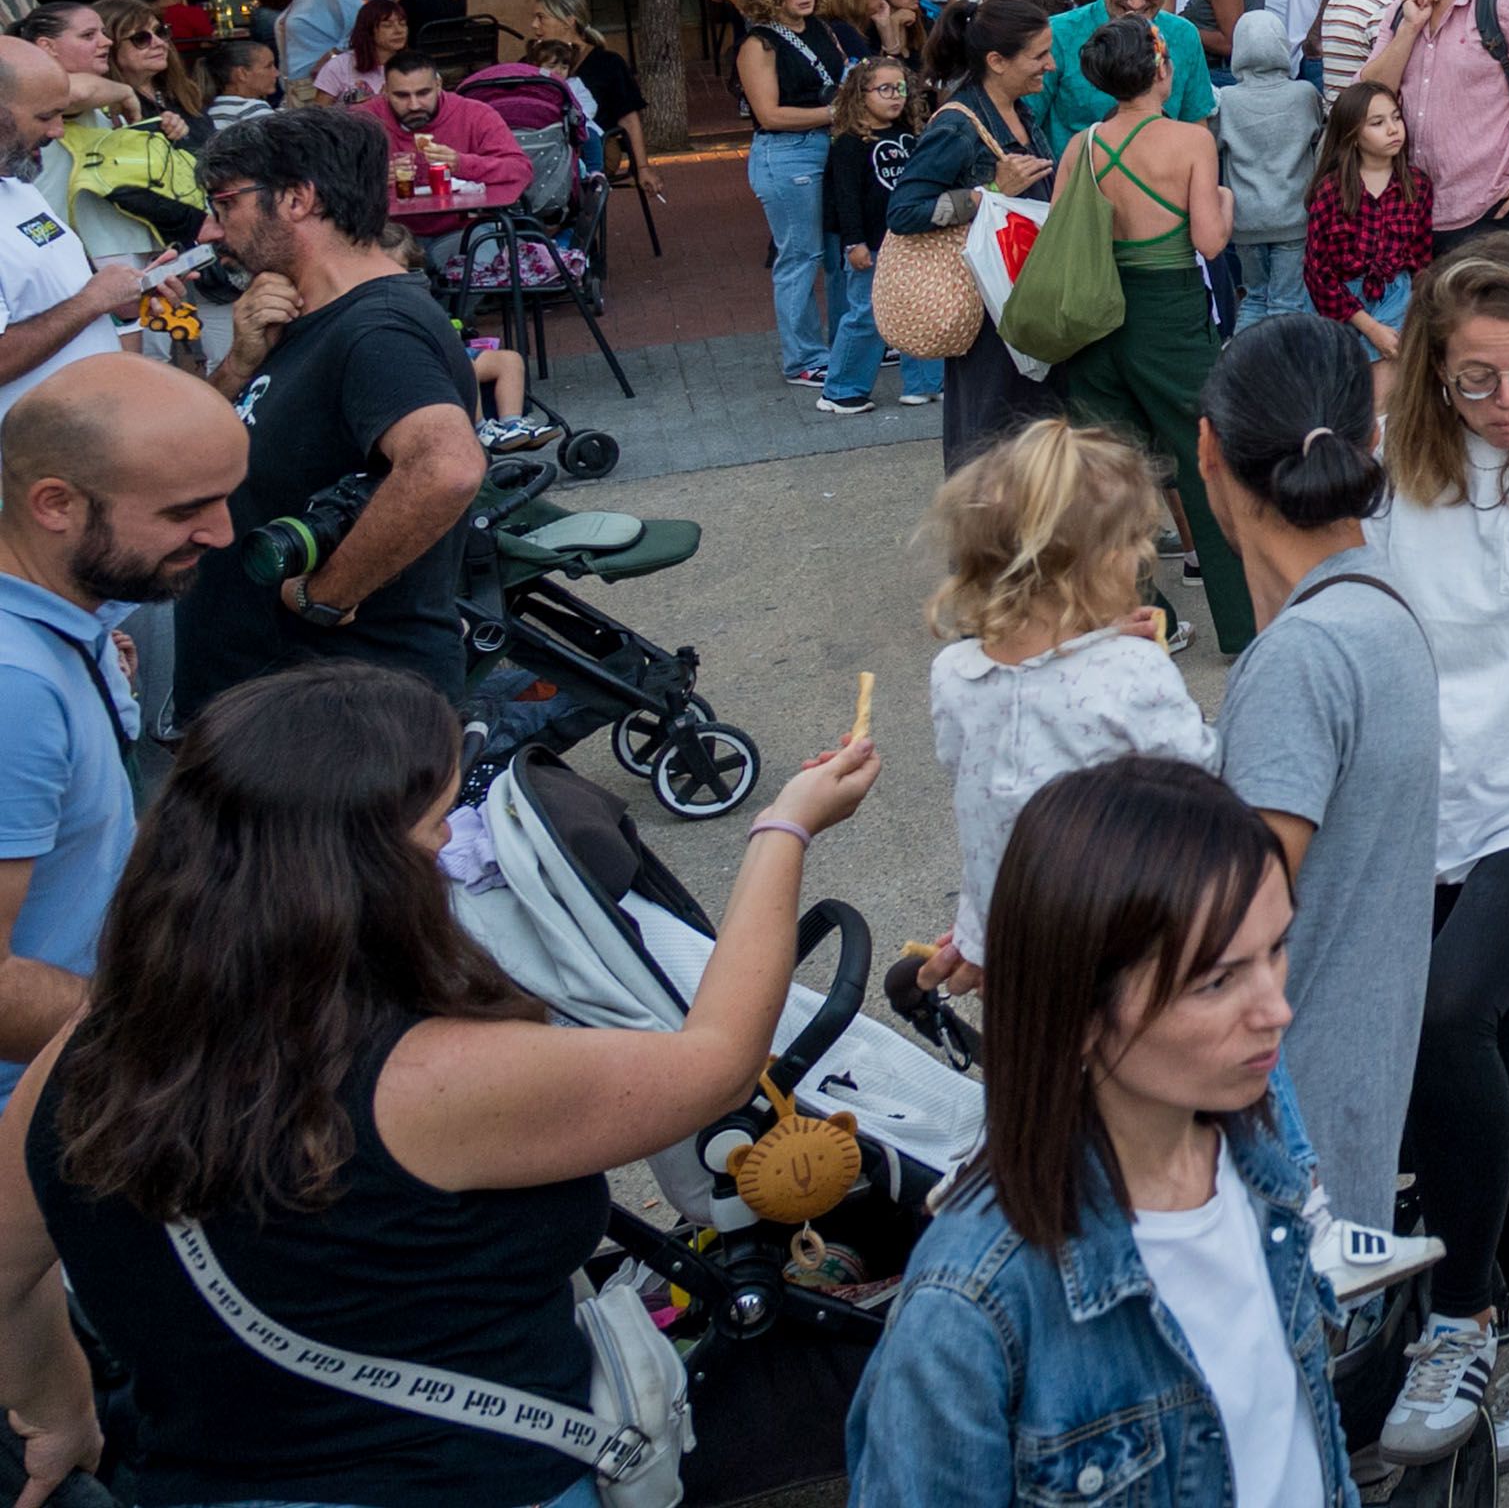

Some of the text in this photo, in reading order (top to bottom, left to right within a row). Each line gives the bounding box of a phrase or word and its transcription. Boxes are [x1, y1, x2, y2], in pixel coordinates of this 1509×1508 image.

[179, 1228, 207, 1271] Girl
[208, 1279, 243, 1317] Girl
[246, 1321, 290, 1352] Girl
[296, 1350, 345, 1373] Girl
[352, 1365, 401, 1389] Girl
[408, 1377, 455, 1403] Girl
[463, 1390, 507, 1417] Girl
[514, 1403, 554, 1430] Girl
[561, 1418, 597, 1447] Girl
